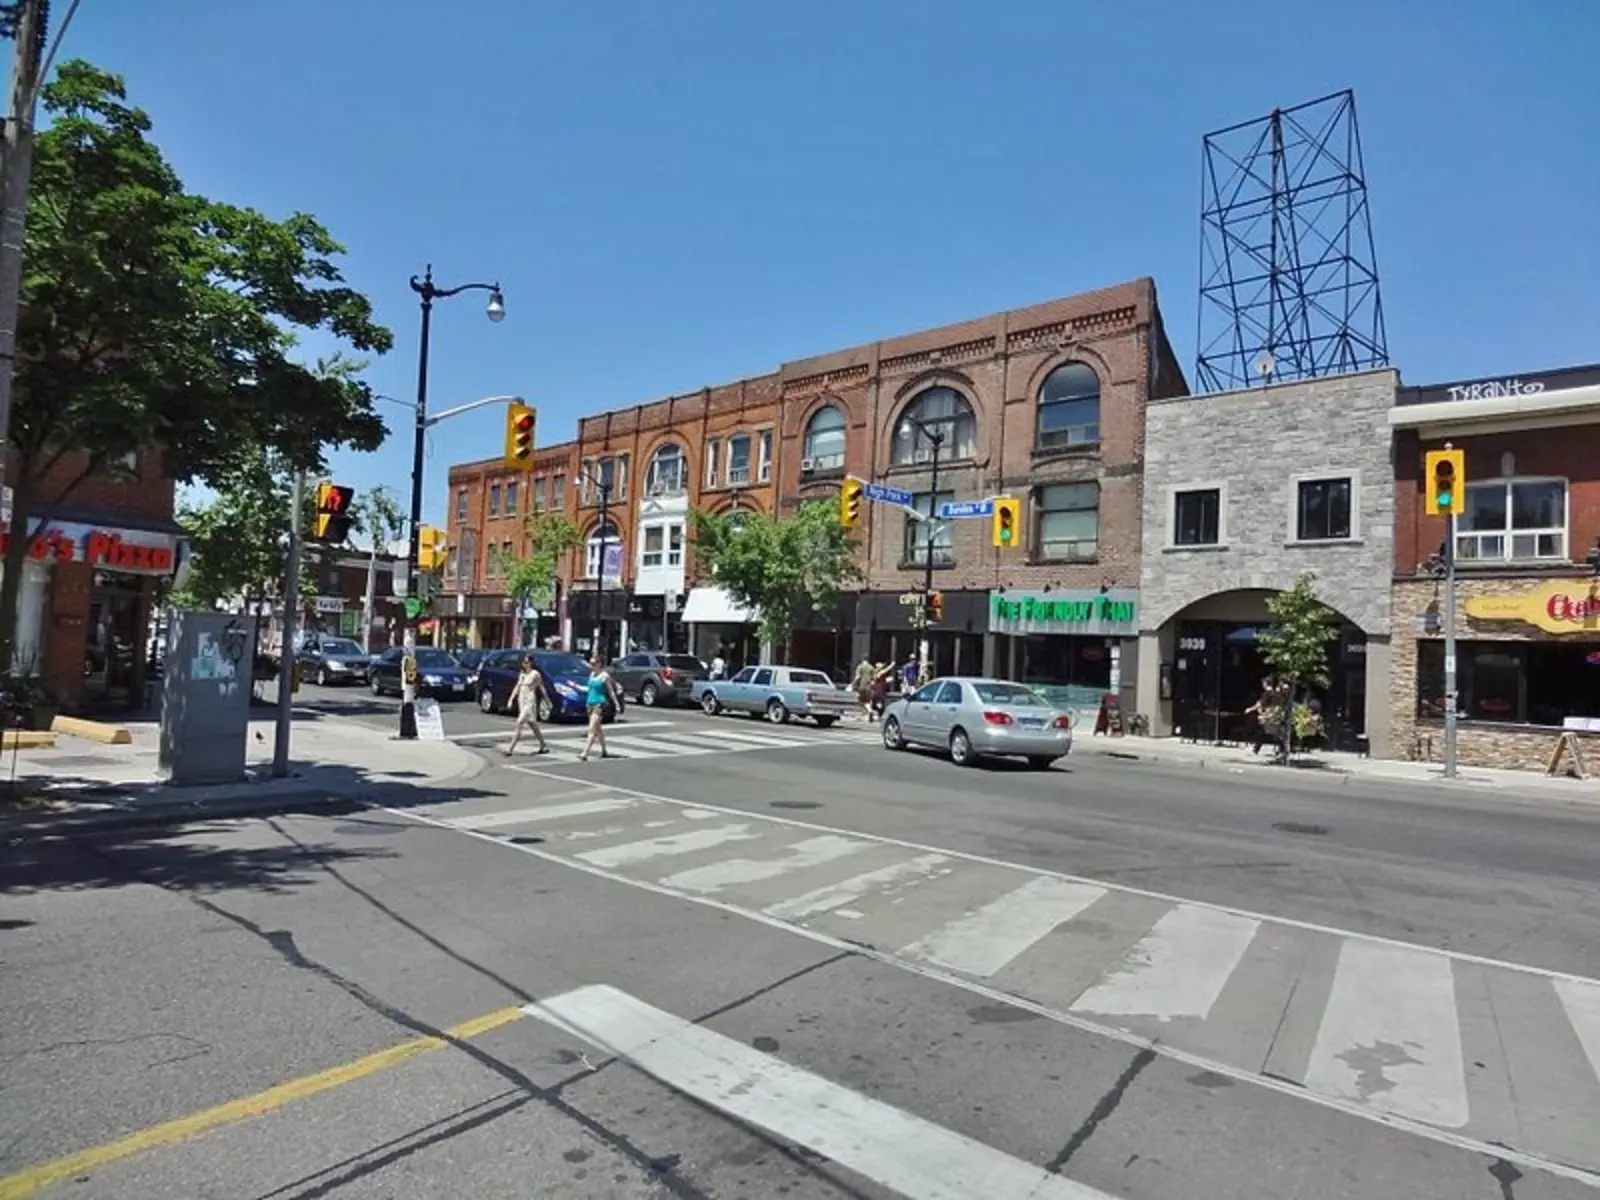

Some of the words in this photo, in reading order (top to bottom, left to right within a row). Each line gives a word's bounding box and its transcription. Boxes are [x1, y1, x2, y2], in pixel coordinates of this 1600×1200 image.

[87, 529, 172, 570] Pizza
[991, 596, 1021, 621] THE
[1022, 596, 1093, 622] FRIENDLY
[1095, 596, 1135, 621] THAI
